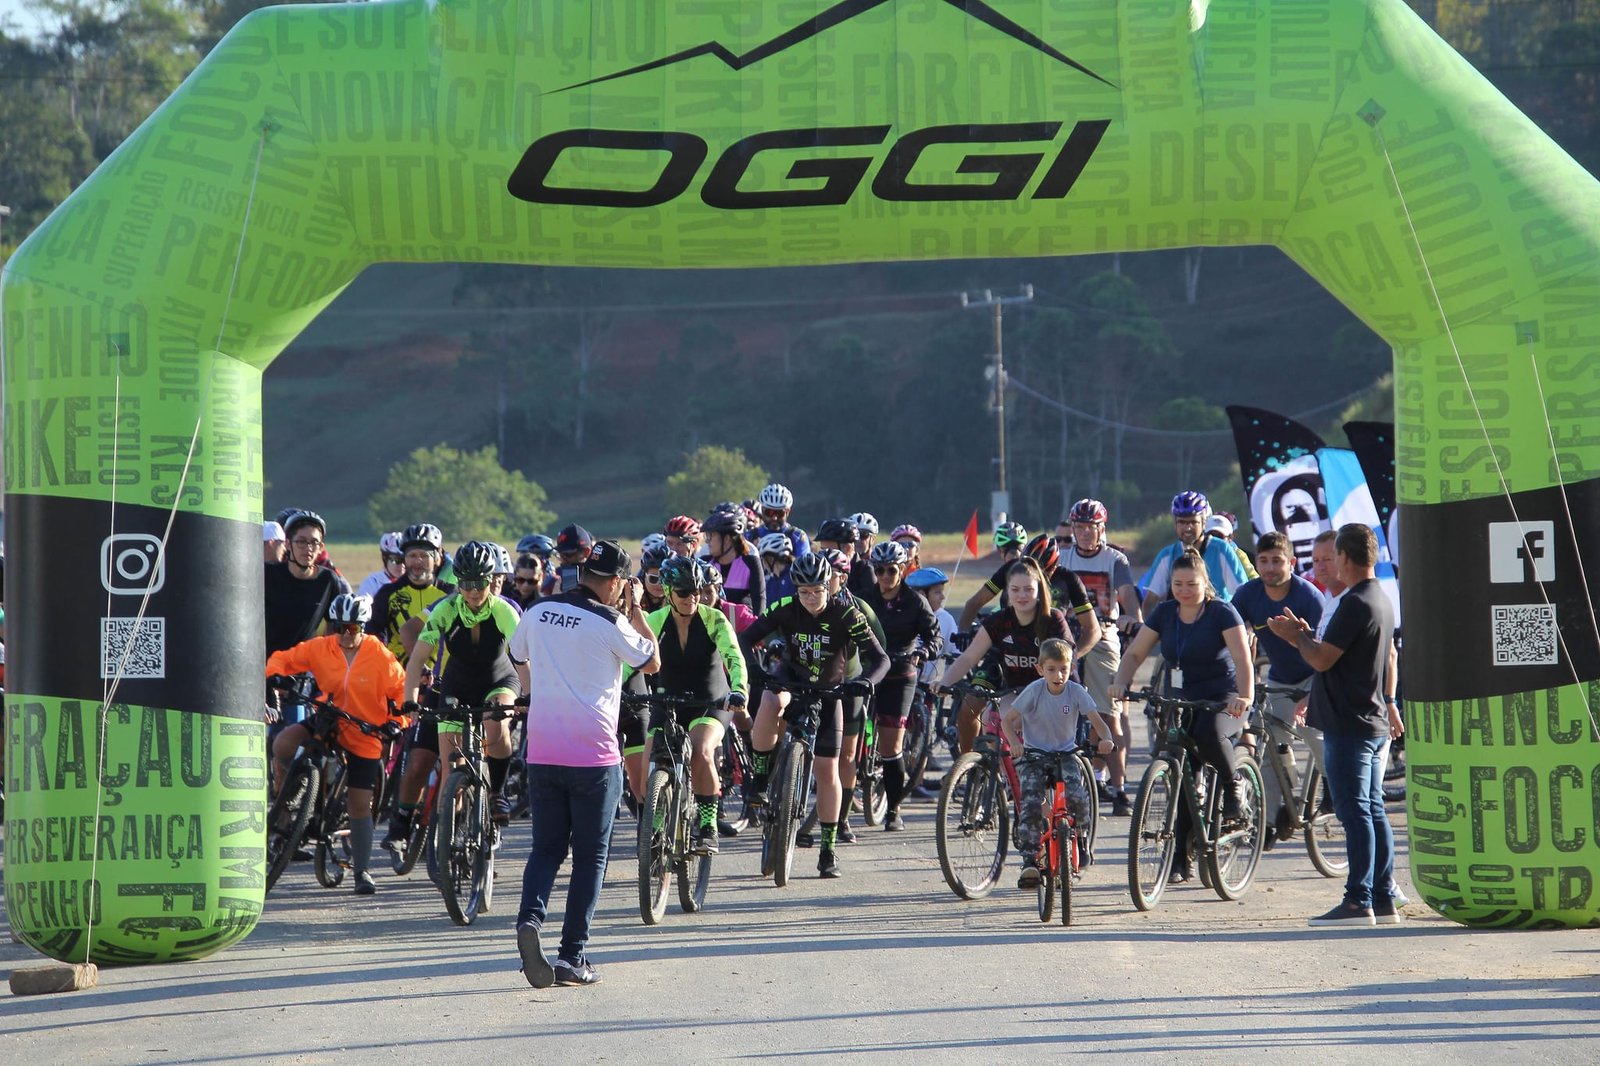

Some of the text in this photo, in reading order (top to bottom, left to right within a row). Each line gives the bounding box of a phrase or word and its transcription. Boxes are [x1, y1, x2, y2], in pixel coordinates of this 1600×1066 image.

[1269, 0, 1331, 102] ATITU
[508, 119, 1111, 209] OGGI
[97, 396, 141, 486] ESTILO
[539, 610, 582, 629] STAFF
